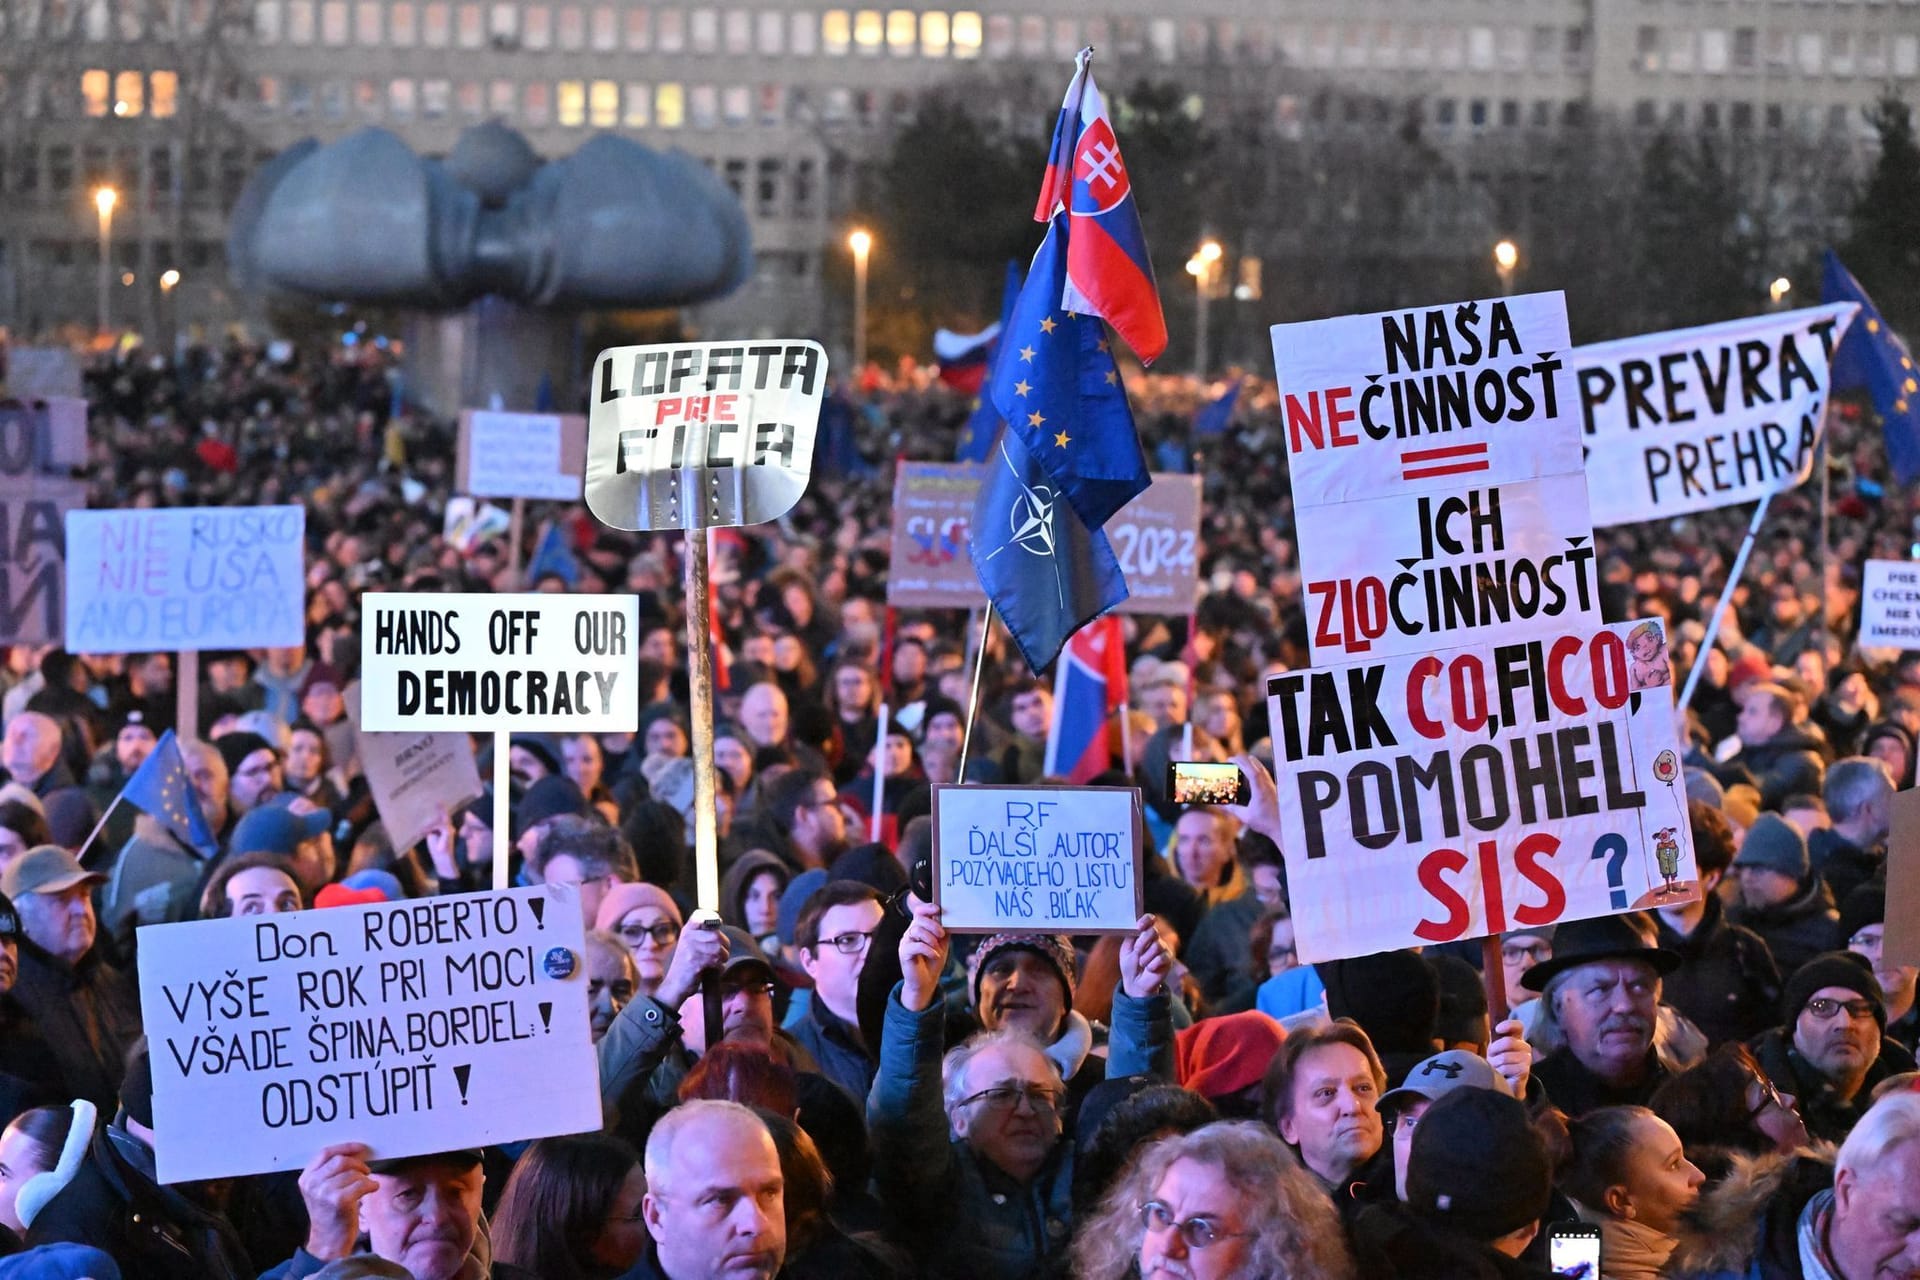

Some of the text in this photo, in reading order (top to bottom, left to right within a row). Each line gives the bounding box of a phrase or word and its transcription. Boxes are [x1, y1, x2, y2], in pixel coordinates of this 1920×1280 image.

[1381, 300, 1523, 375] NAŠA
[600, 346, 819, 404] LOPATA
[1284, 351, 1563, 454] NEČINNOSŤ
[1576, 314, 1837, 435] PREVRAT
[655, 394, 739, 426] PRE
[616, 422, 795, 475] FICA
[100, 508, 299, 554] NIE RUSKO
[1417, 487, 1505, 561] ICH
[98, 550, 281, 597] NIE USA
[1307, 536, 1594, 654] ZLOČINNOSŤ
[375, 609, 626, 656] HANDS OFF OUR
[397, 670, 619, 716] DEMOCRACY
[1266, 664, 1399, 763] TAK
[1006, 801, 1058, 828] RF
[1296, 720, 1647, 860] POMOHEL
[968, 824, 1039, 857] ĎALŠÍ
[255, 921, 338, 962] Don
[363, 897, 518, 952] ROBERTO
[995, 886, 1033, 918] NÁŠ
[161, 969, 270, 1024] VYŠE
[297, 965, 368, 1013] ROK
[380, 957, 428, 1003] PRI
[445, 945, 536, 996] MOCI
[165, 1025, 294, 1078] VŠADE
[262, 1053, 437, 1129] ODSTÚPIŤ
